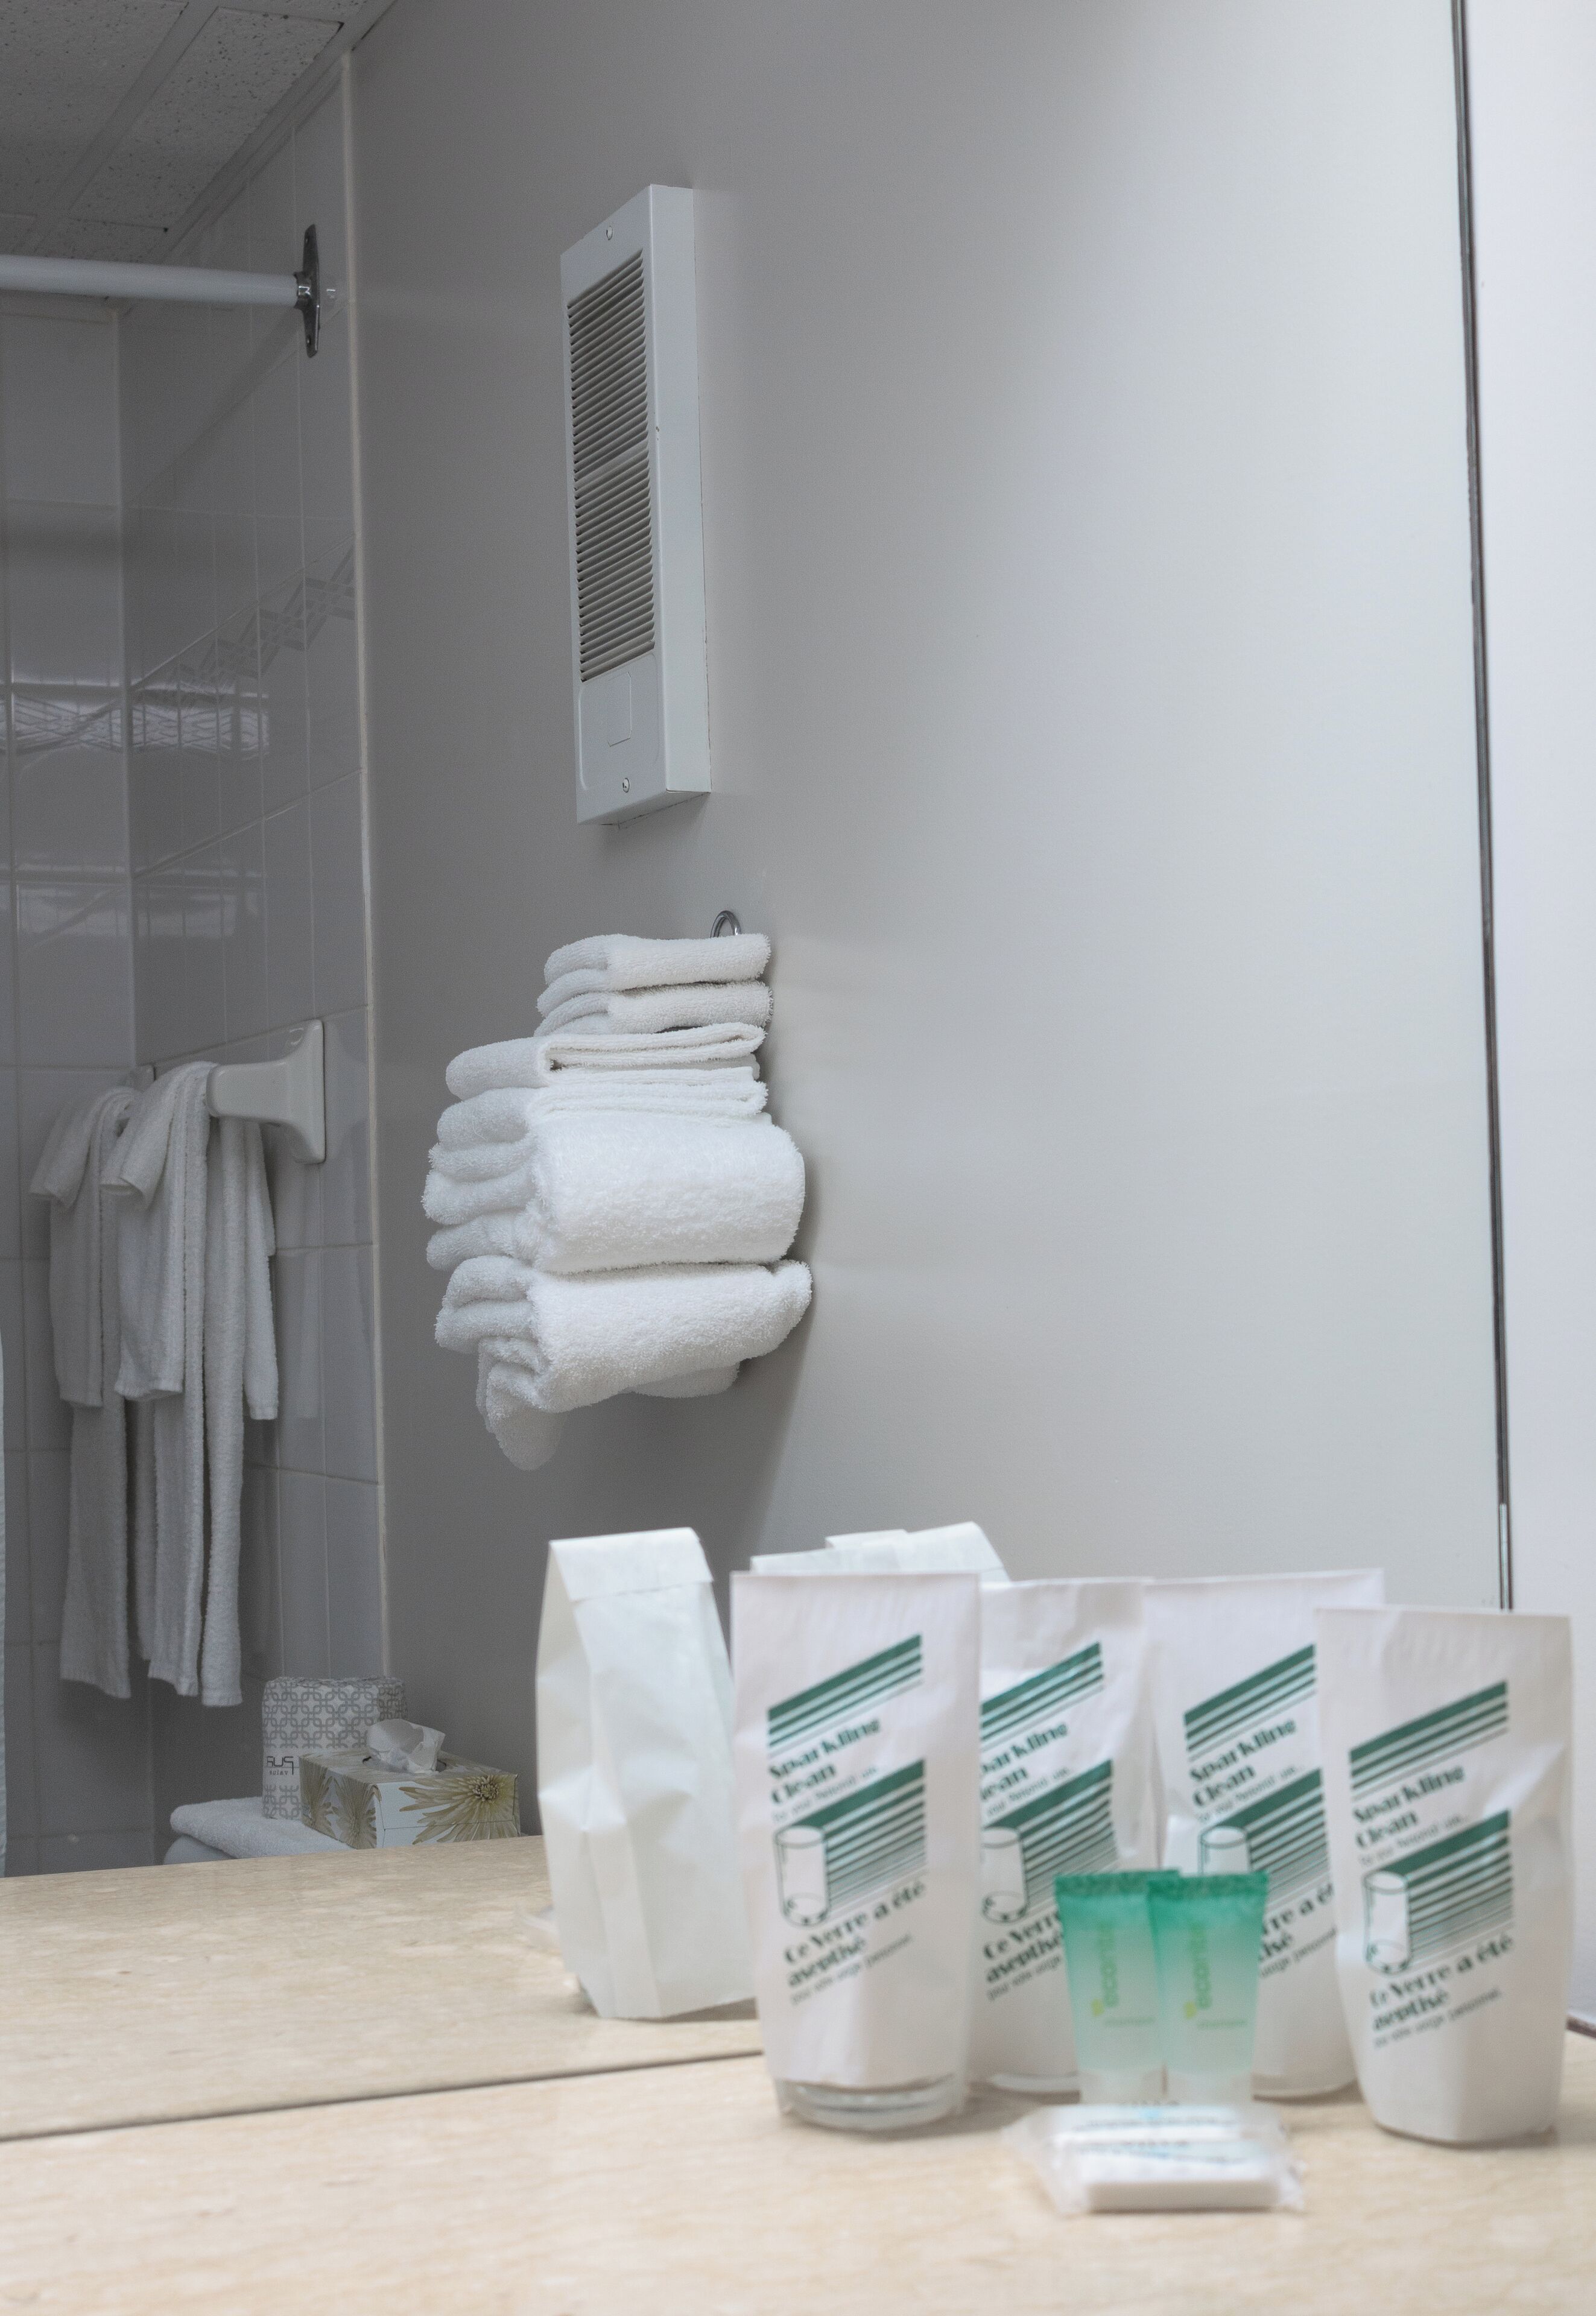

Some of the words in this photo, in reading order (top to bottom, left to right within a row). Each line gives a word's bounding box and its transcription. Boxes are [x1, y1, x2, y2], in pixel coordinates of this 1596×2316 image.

[770, 1717, 881, 1777] Sparkling
[1190, 1719, 1296, 1781] Sparkling
[771, 1764, 836, 1804] Clean
[1192, 1764, 1256, 1807] Clean
[1354, 1765, 1465, 1823] Sparkling
[1357, 1811, 1419, 1849] Clean
[873, 1902, 889, 1920] a
[891, 1880, 925, 1909] été
[1300, 1899, 1314, 1916] a
[1457, 1956, 1473, 1974] a
[1477, 1934, 1512, 1963] été
